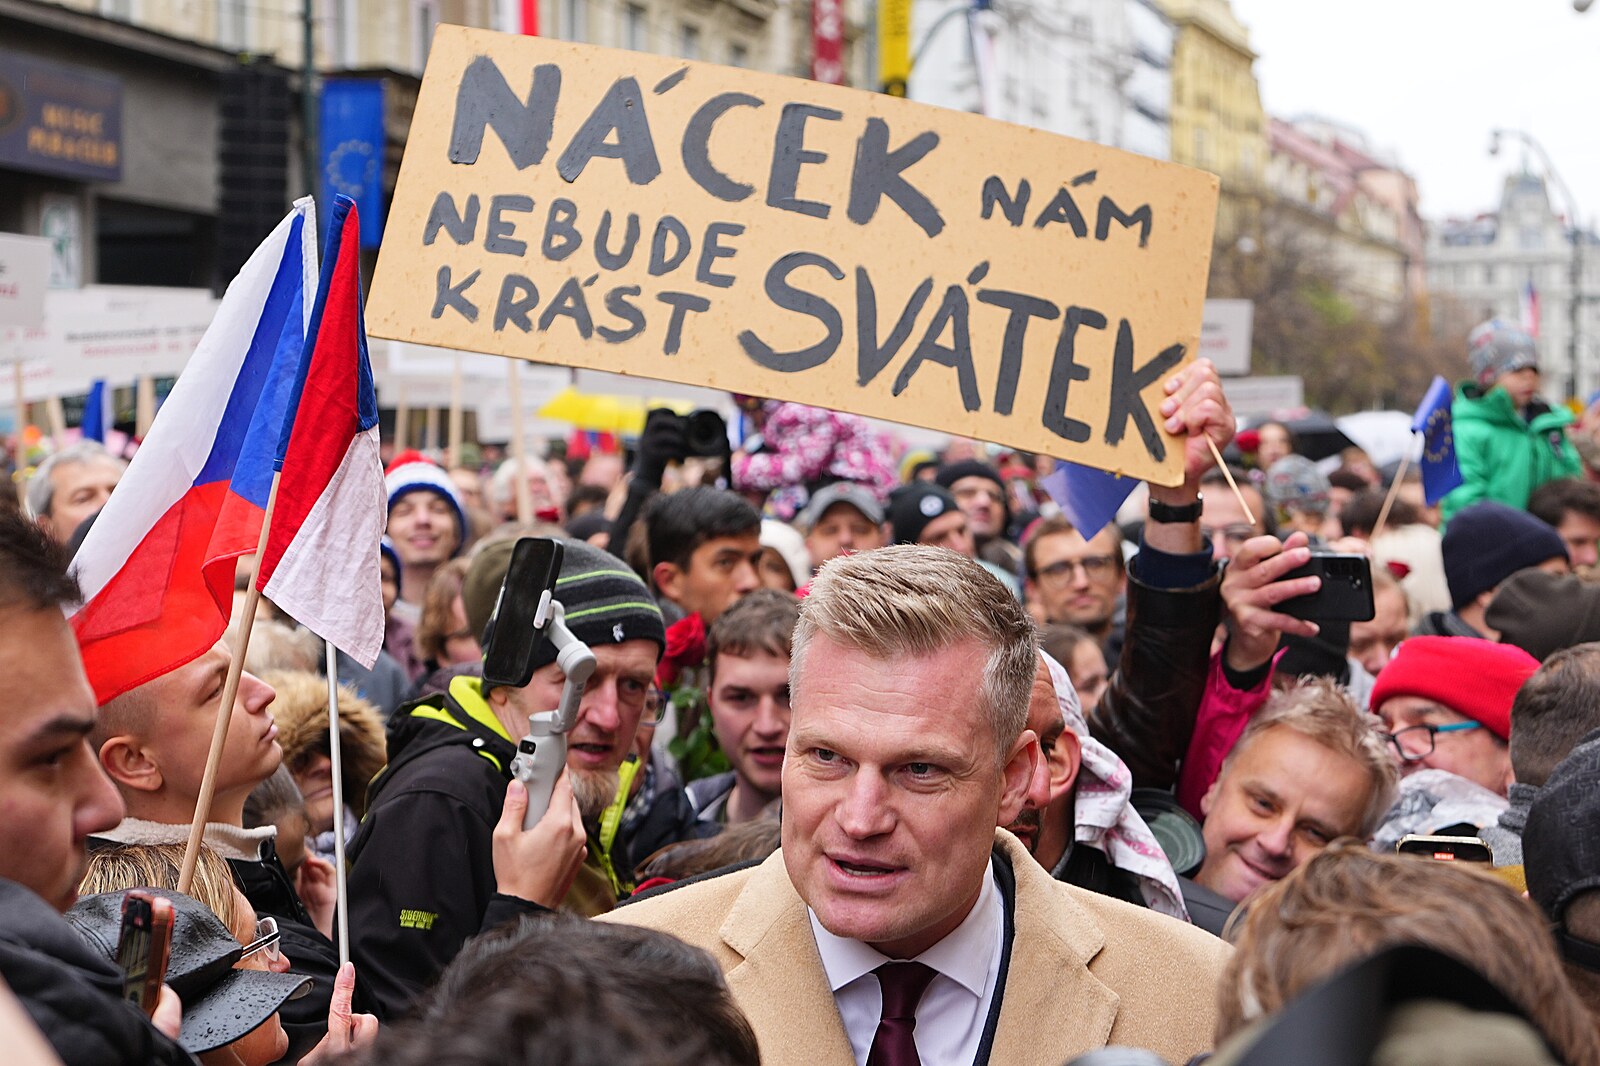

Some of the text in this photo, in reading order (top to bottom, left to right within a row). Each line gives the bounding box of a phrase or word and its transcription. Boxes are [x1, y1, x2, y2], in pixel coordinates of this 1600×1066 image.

[423, 191, 745, 288] NEBUDE
[448, 56, 1152, 248] NÁCEK NÁM
[431, 251, 1186, 462] KRÁST SVÁTEK
